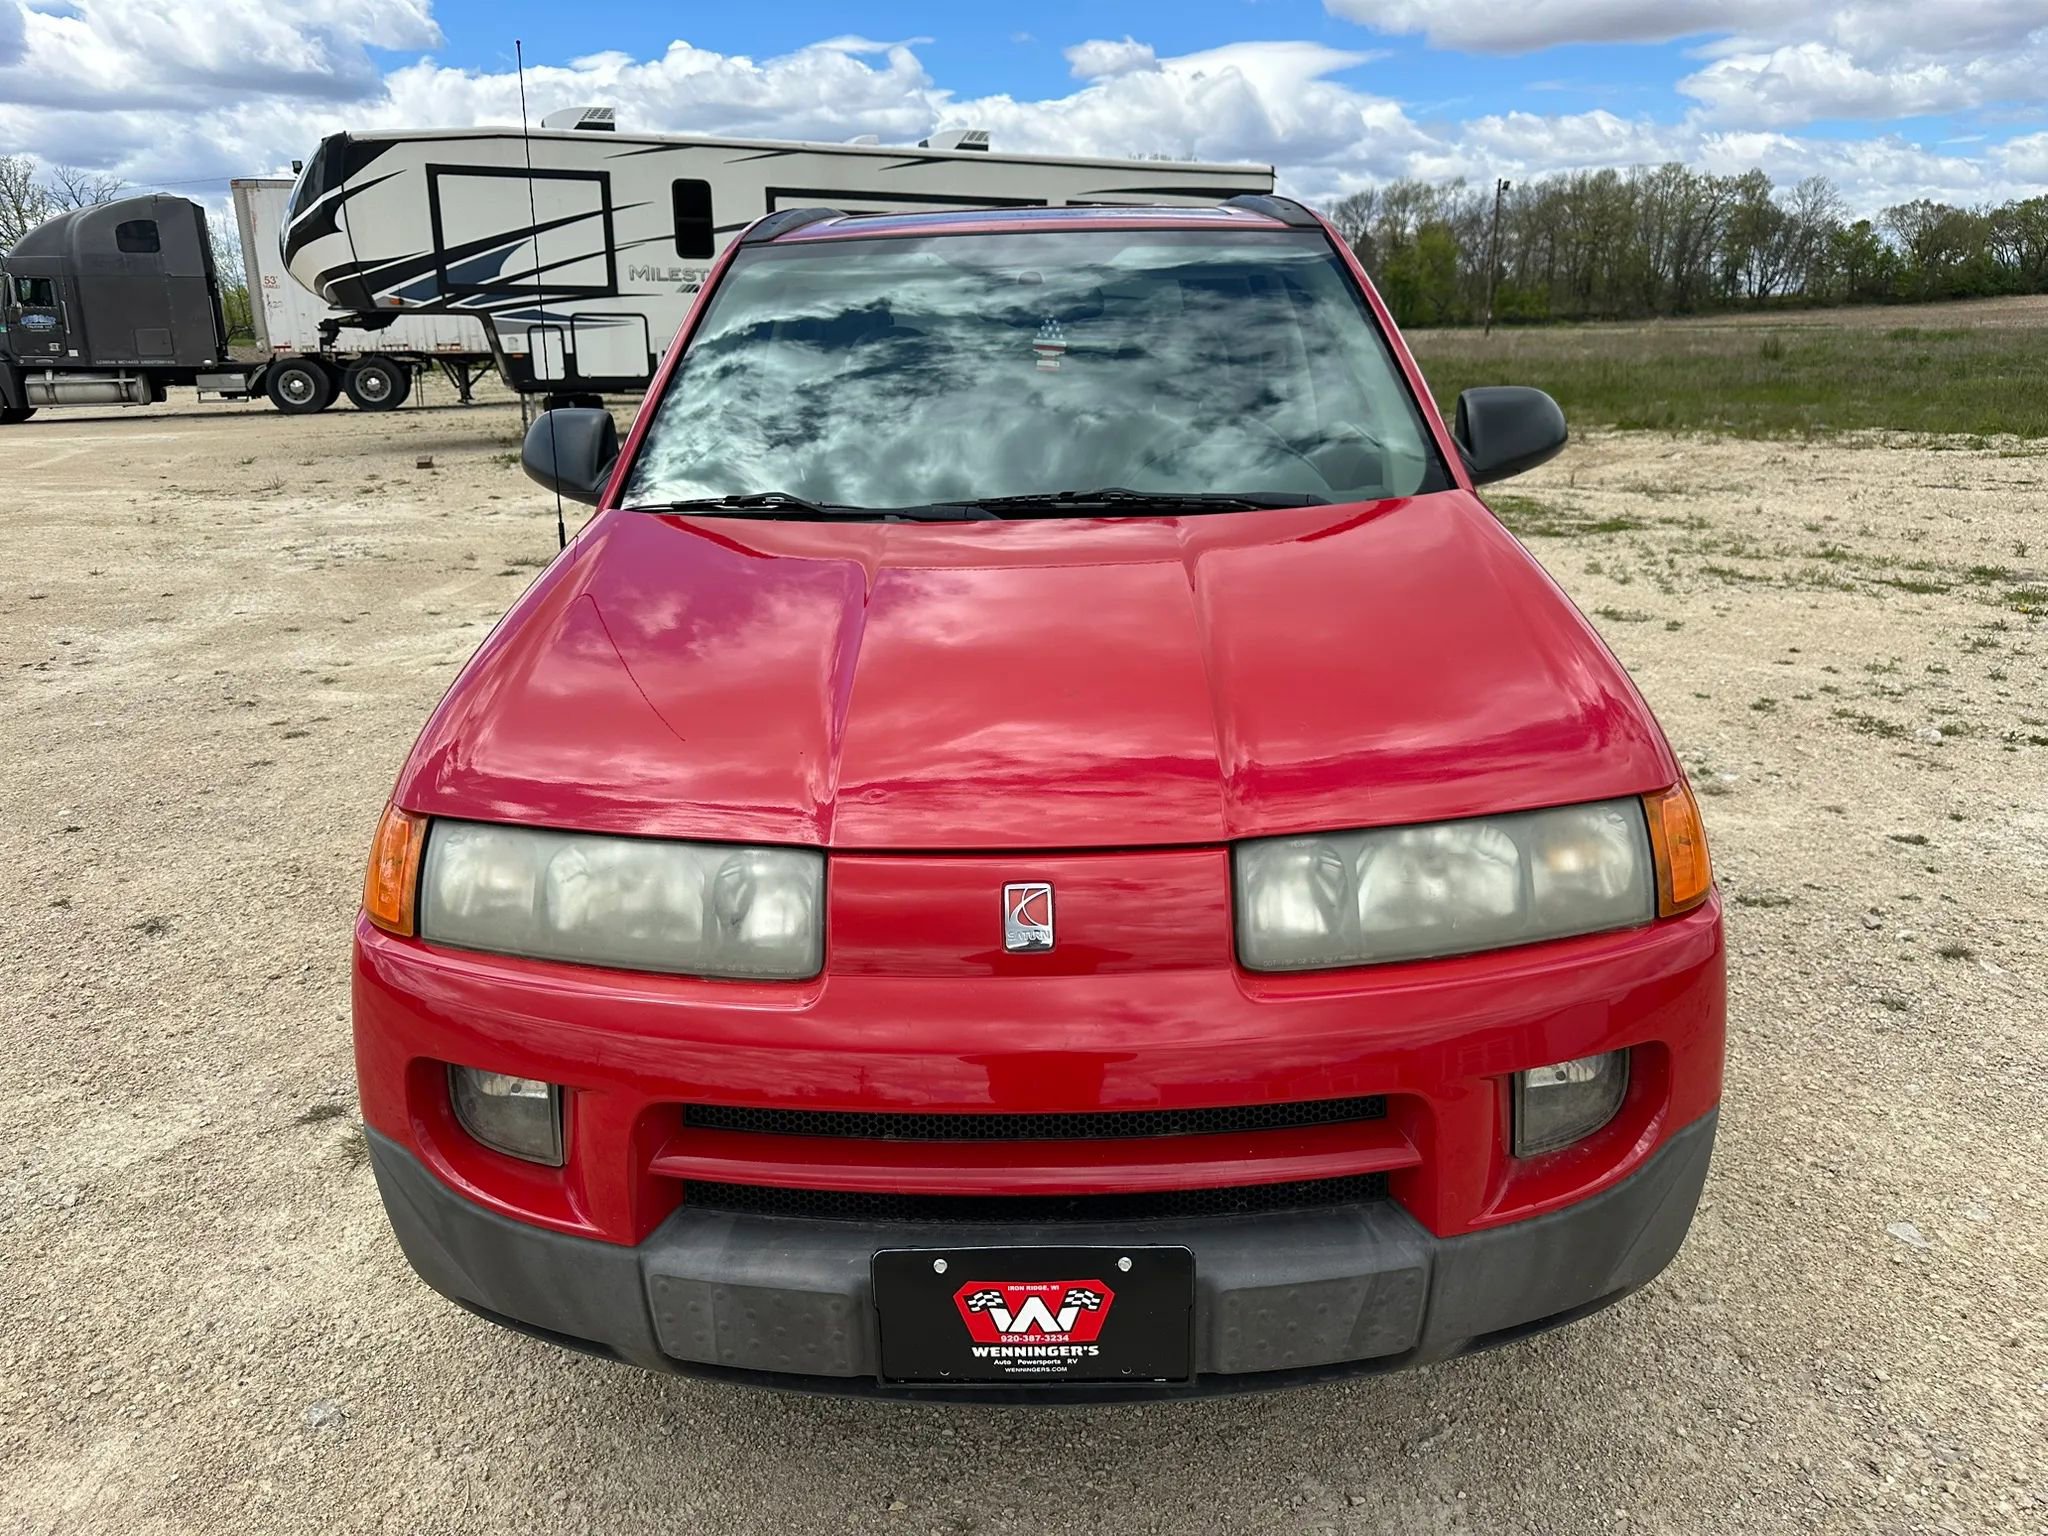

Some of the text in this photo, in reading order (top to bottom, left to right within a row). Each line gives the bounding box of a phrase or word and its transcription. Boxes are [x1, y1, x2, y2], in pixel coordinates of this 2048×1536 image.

[1007, 929, 1051, 942] SATURN
[1001, 1334, 1069, 1342] 920-387-3234
[971, 1345, 1100, 1357] WENNINGER'S
